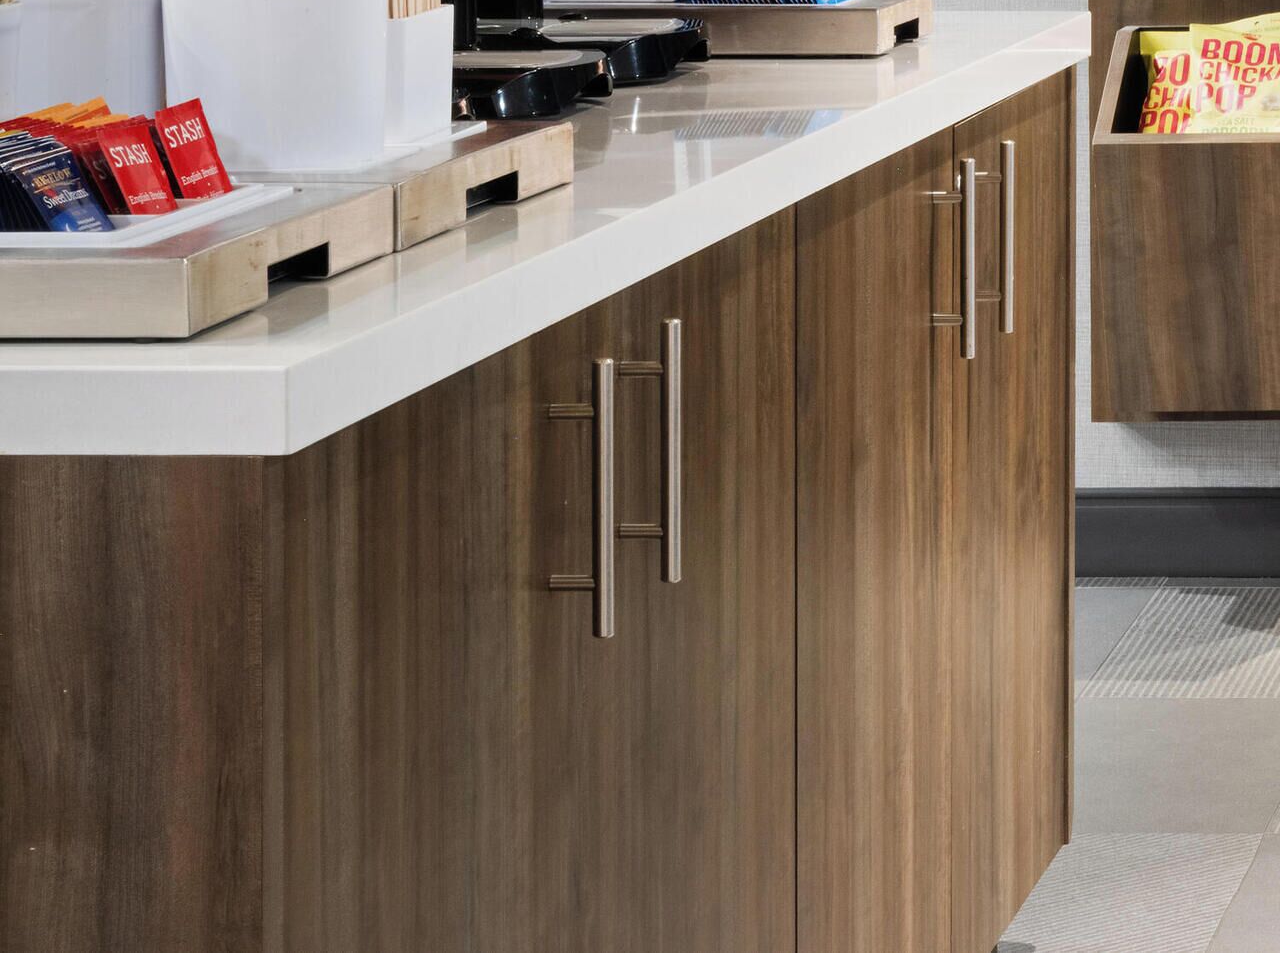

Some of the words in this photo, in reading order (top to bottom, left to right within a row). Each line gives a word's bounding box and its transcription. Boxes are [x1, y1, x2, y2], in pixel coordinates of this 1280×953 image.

[164, 117, 205, 149] STASH
[109, 143, 153, 169] STASH
[180, 171, 202, 186] English
[128, 192, 149, 206] English
